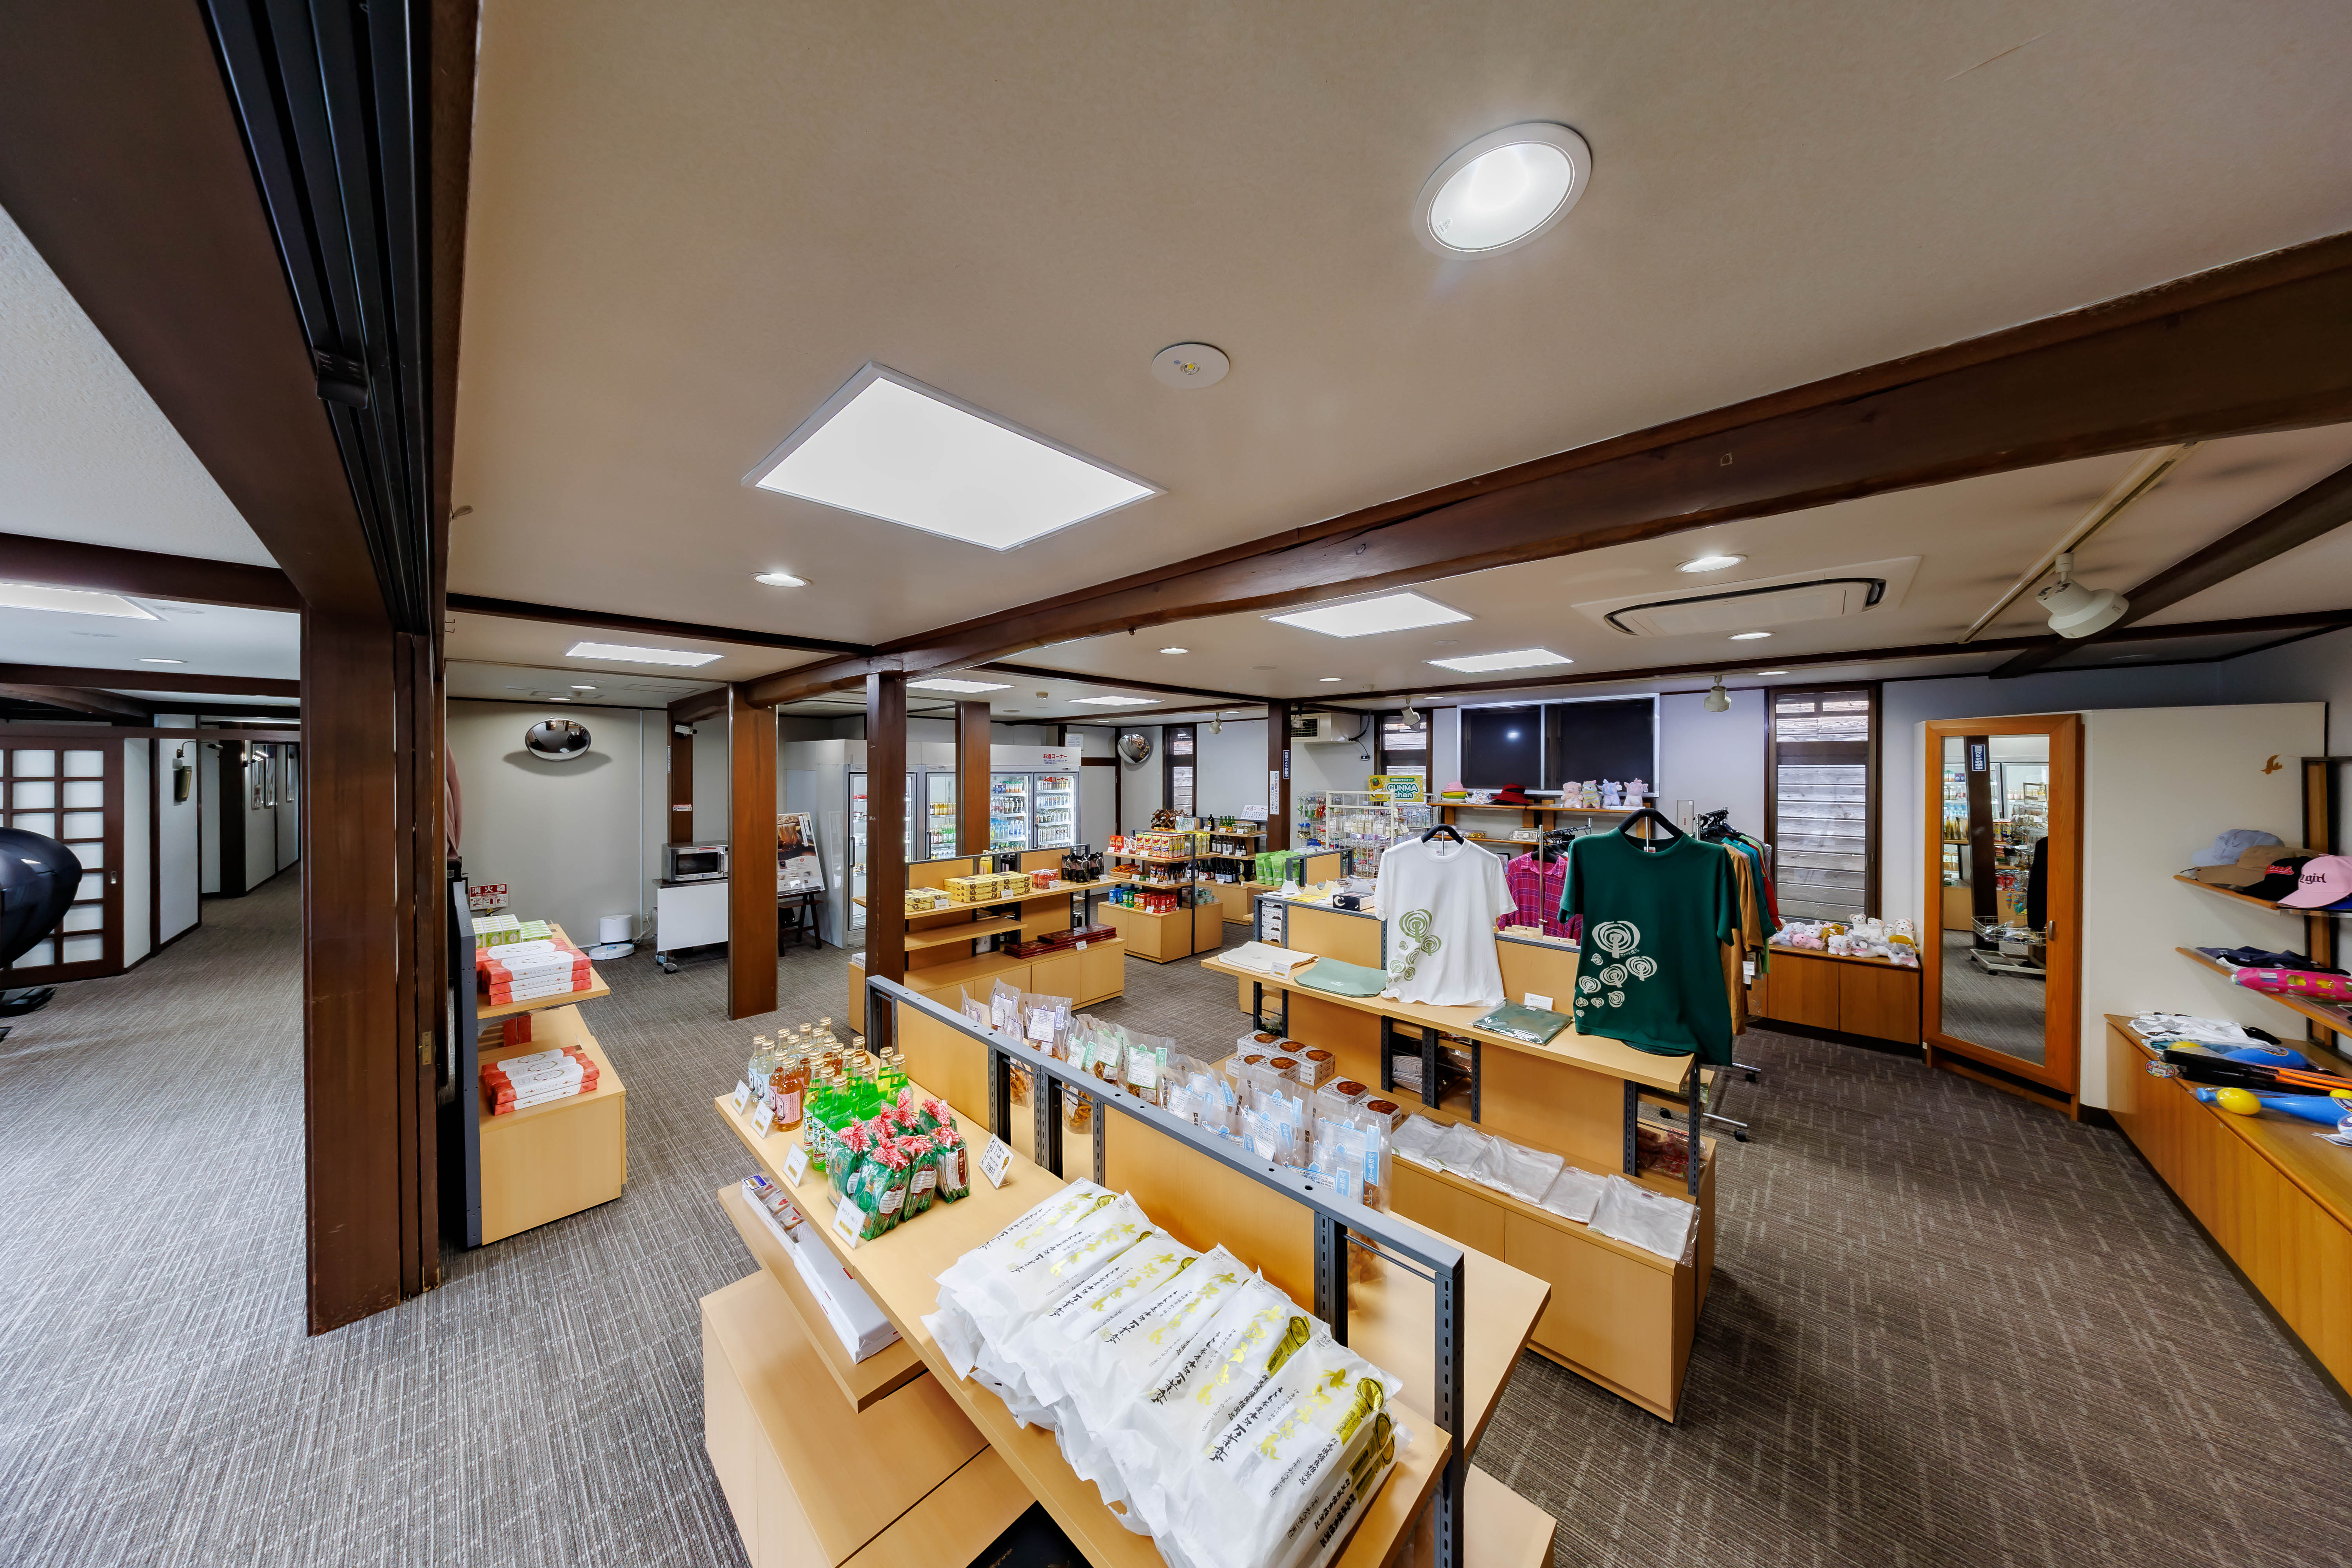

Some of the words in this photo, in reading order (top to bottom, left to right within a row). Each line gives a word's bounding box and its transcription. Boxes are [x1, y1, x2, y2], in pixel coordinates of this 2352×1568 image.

[472, 885, 506, 894] 消火器
[536, 1083, 562, 1091] りんごクッキー
[985, 1161, 995, 1176] 790円
[1014, 1192, 1094, 1250] 水沢うどん
[1050, 1222, 1136, 1277] 水沢うどん
[1091, 1253, 1176, 1312] 水沢うどん
[1149, 1272, 1238, 1345] 水沢うどん
[1197, 1305, 1285, 1406] 水沢うどん
[1260, 1368, 1350, 1461] 水沢うどん
[1298, 1437, 1339, 1486] 群馬県優良推奨品
